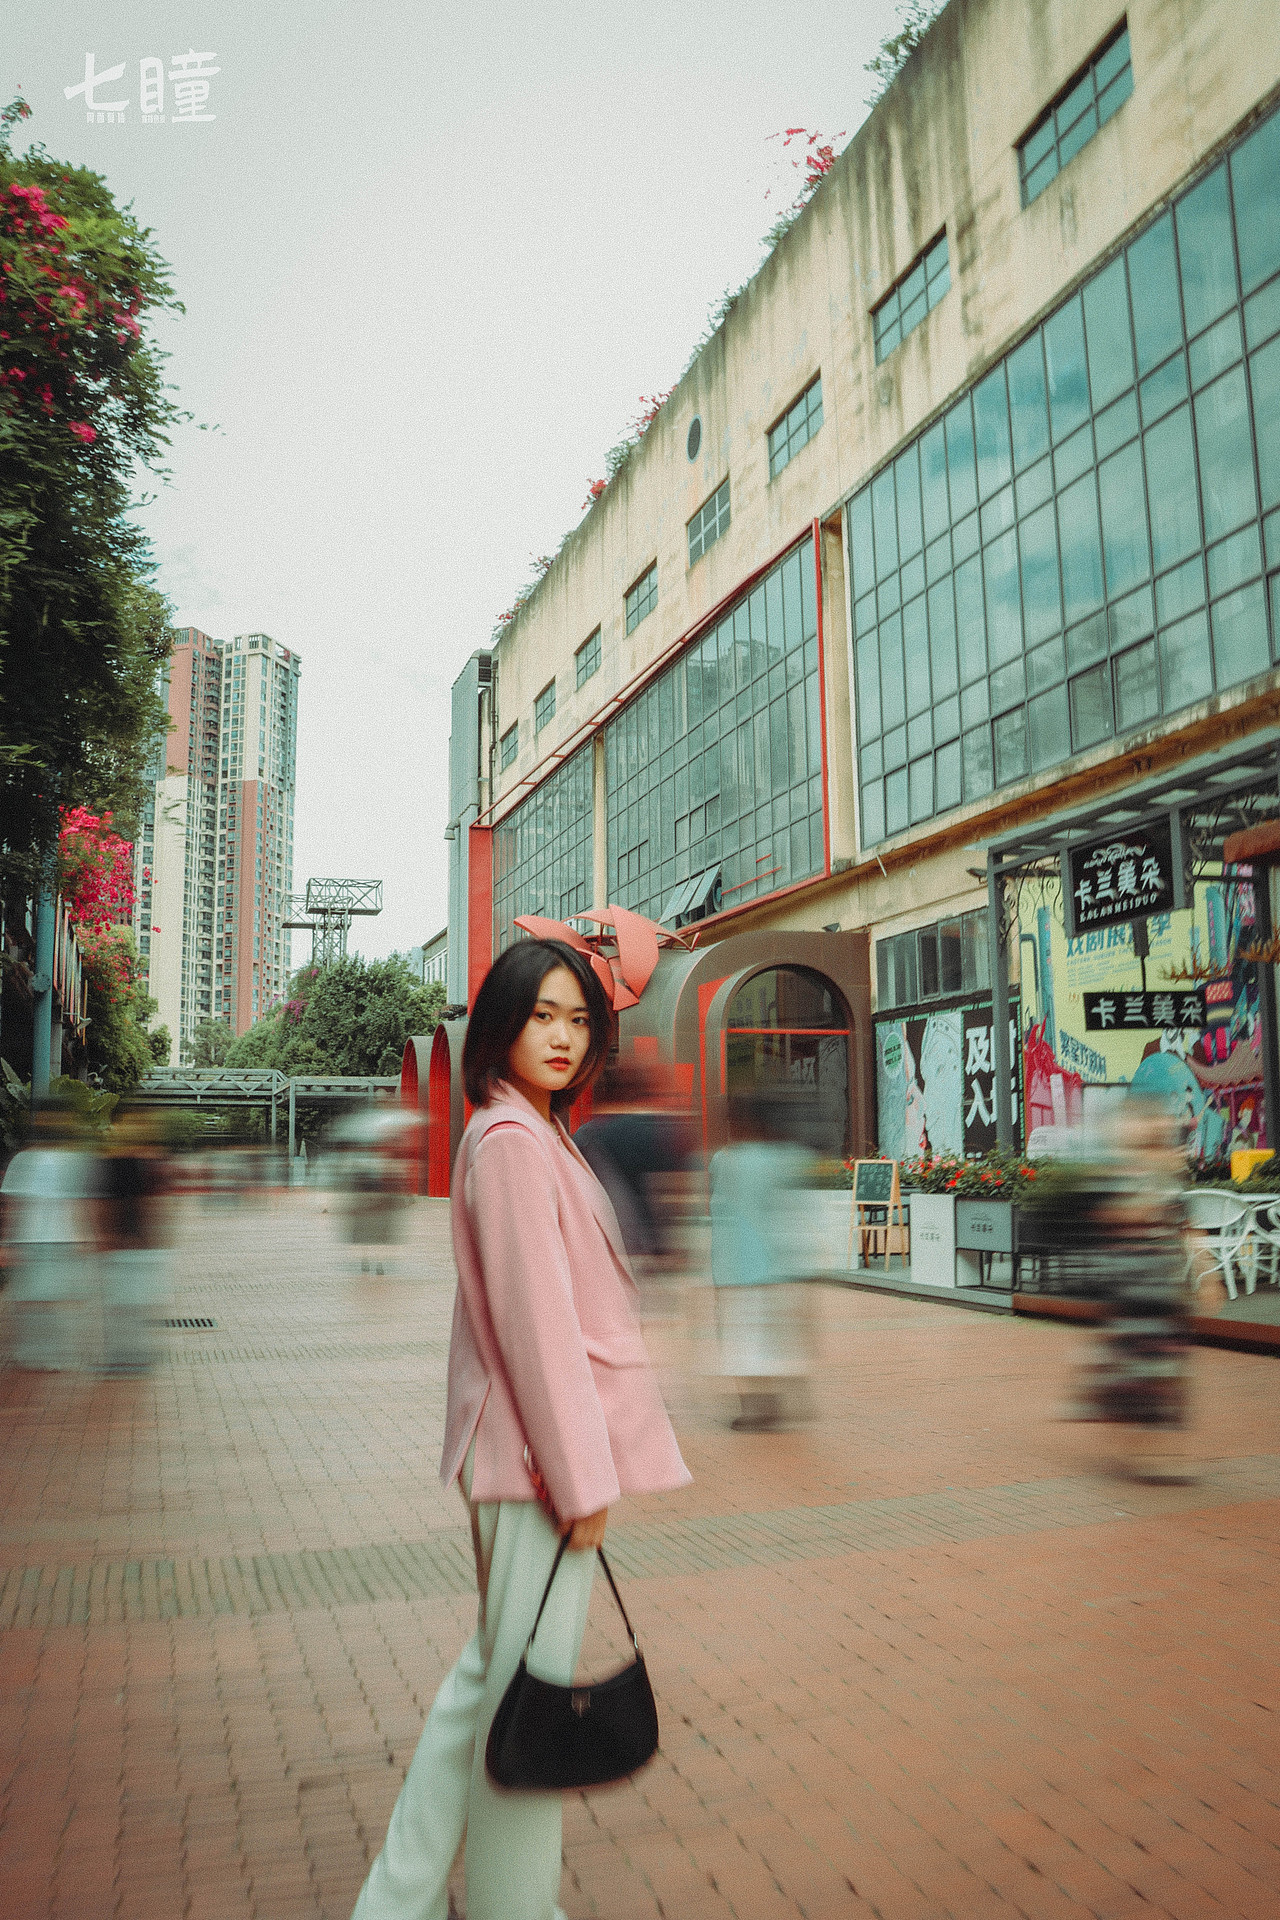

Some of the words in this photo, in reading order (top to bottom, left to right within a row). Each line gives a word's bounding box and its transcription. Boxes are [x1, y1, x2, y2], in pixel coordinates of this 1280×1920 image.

[1075, 857, 1164, 911] 卡兰美朵
[1091, 994, 1203, 1028] 卡兰美朵
